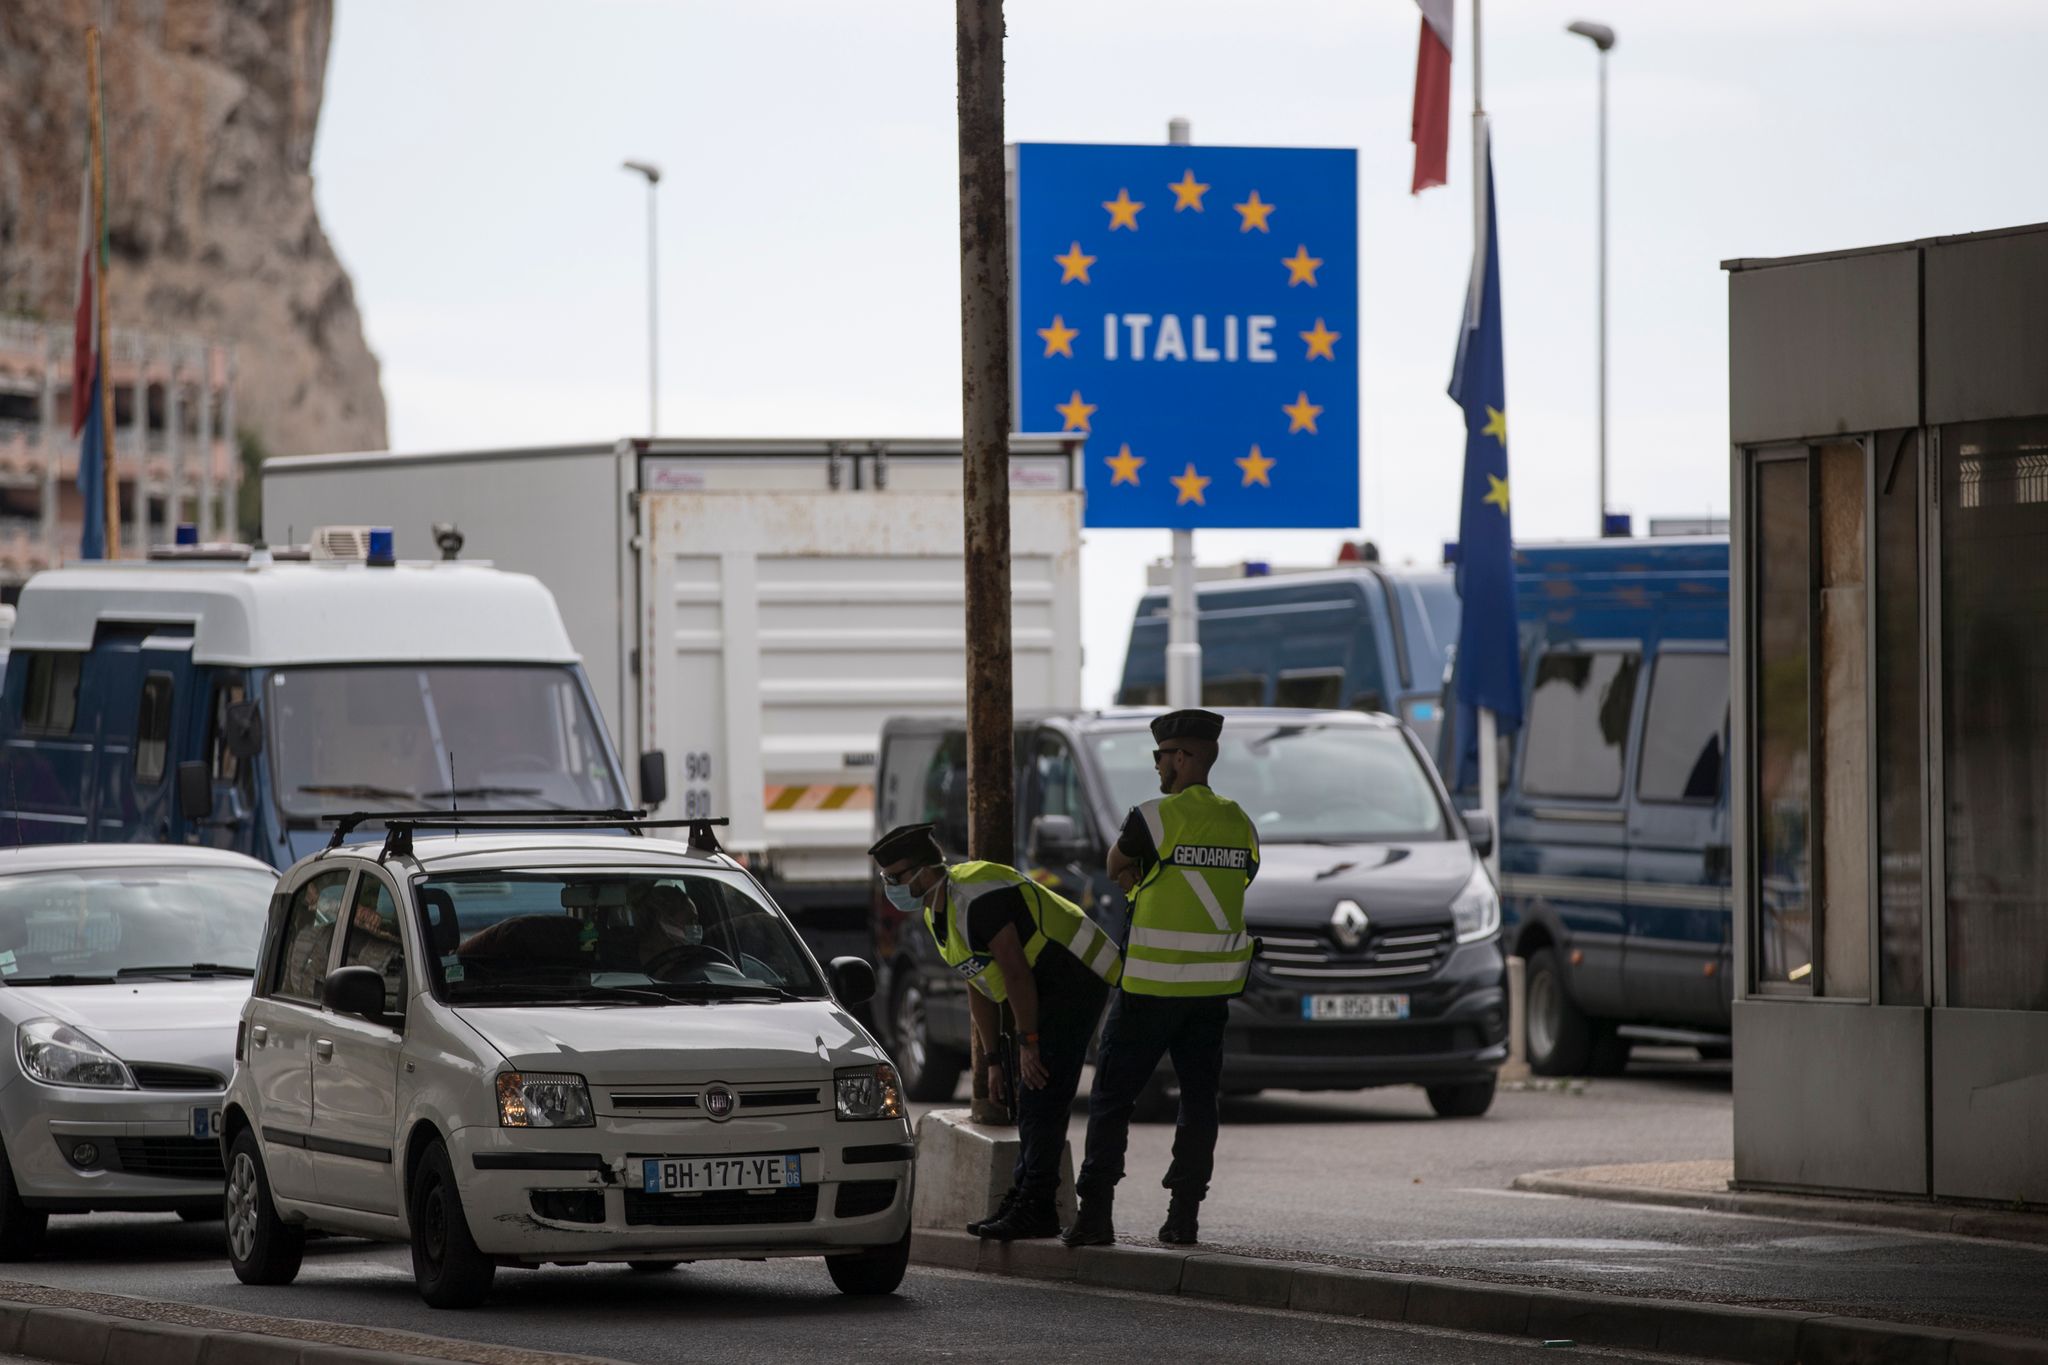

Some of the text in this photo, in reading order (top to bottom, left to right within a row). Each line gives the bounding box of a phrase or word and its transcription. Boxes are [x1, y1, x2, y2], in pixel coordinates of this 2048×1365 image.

[1104, 313, 1277, 362] ITALIE
[686, 753, 711, 781] 90
[1174, 845, 1249, 869] GENDARMER
[787, 1171, 800, 1184] 06
